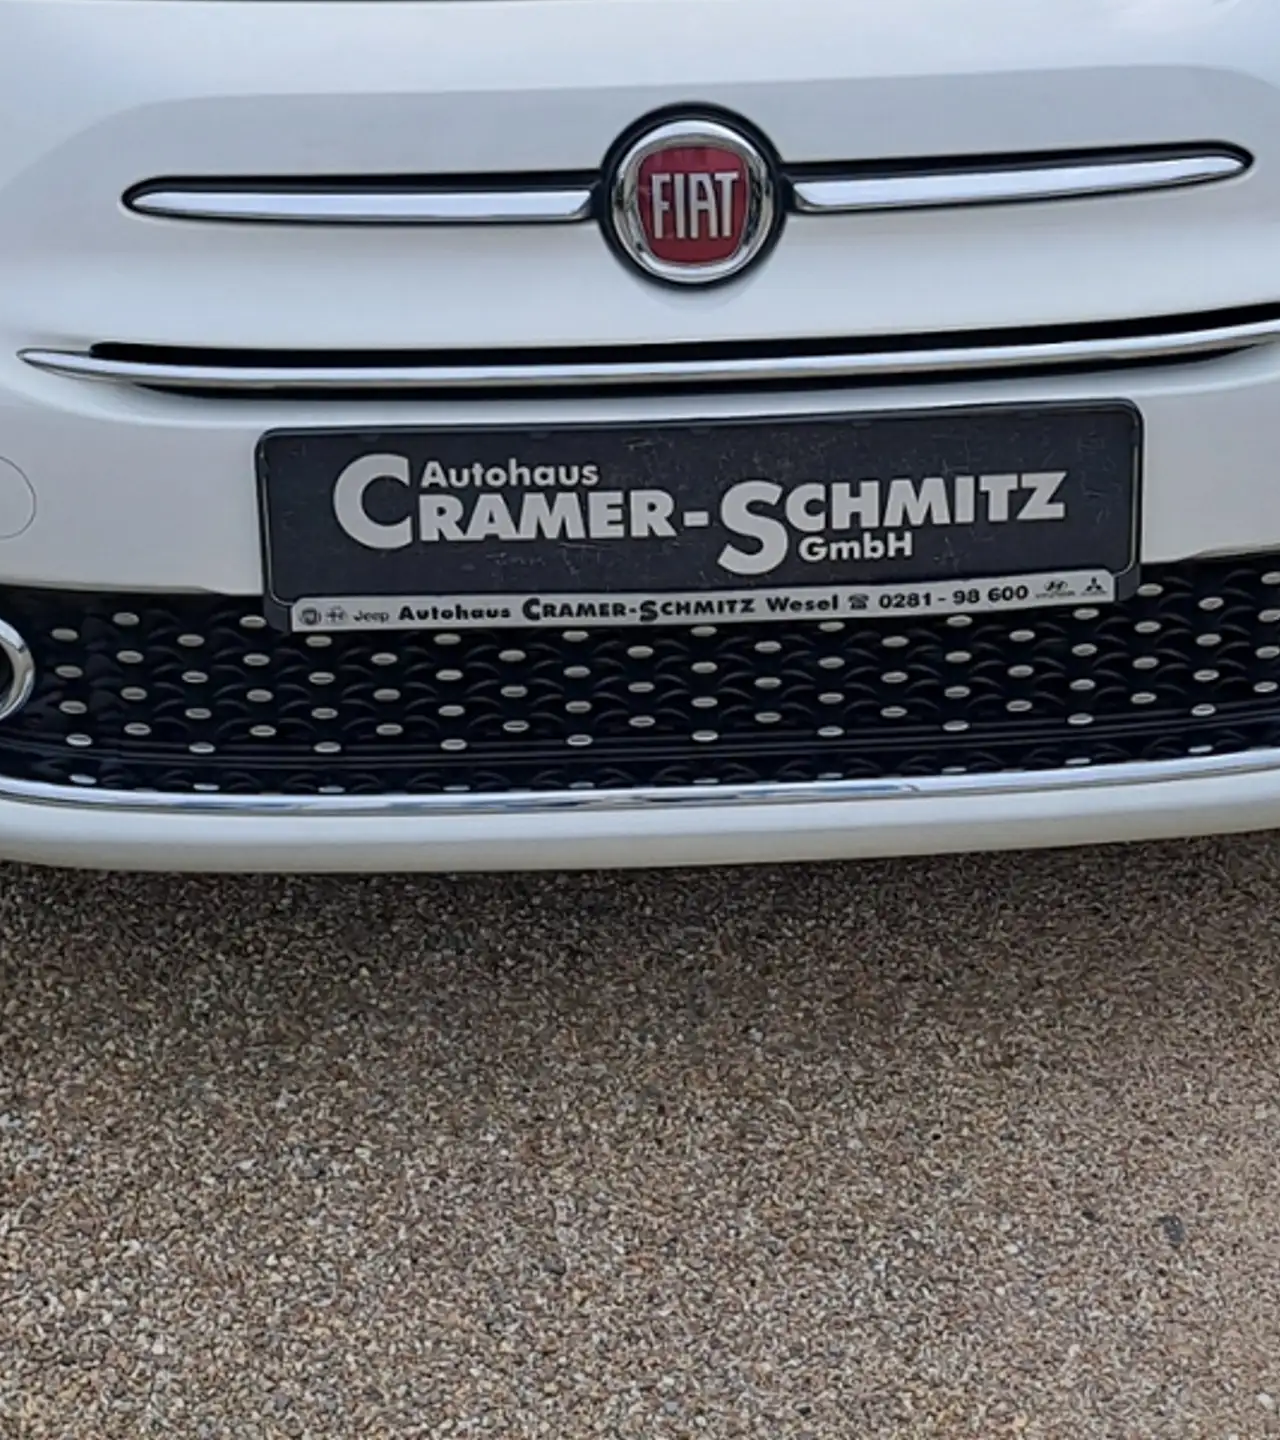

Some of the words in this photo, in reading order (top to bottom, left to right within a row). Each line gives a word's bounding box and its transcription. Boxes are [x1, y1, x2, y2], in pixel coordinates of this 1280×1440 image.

[651, 170, 739, 240] FIAT
[421, 458, 600, 488] Autohaus
[333, 453, 1067, 576] CRAMER-SCHMITZ
[798, 531, 913, 562] GmbH
[353, 609, 390, 623] Jeep
[398, 603, 511, 621] Autohaus
[522, 597, 755, 623] CRAMER-SCHMITZ
[766, 594, 839, 612] Wesel
[879, 592, 932, 609] 0281
[952, 588, 980, 605] 98
[987, 585, 1029, 602] 600
